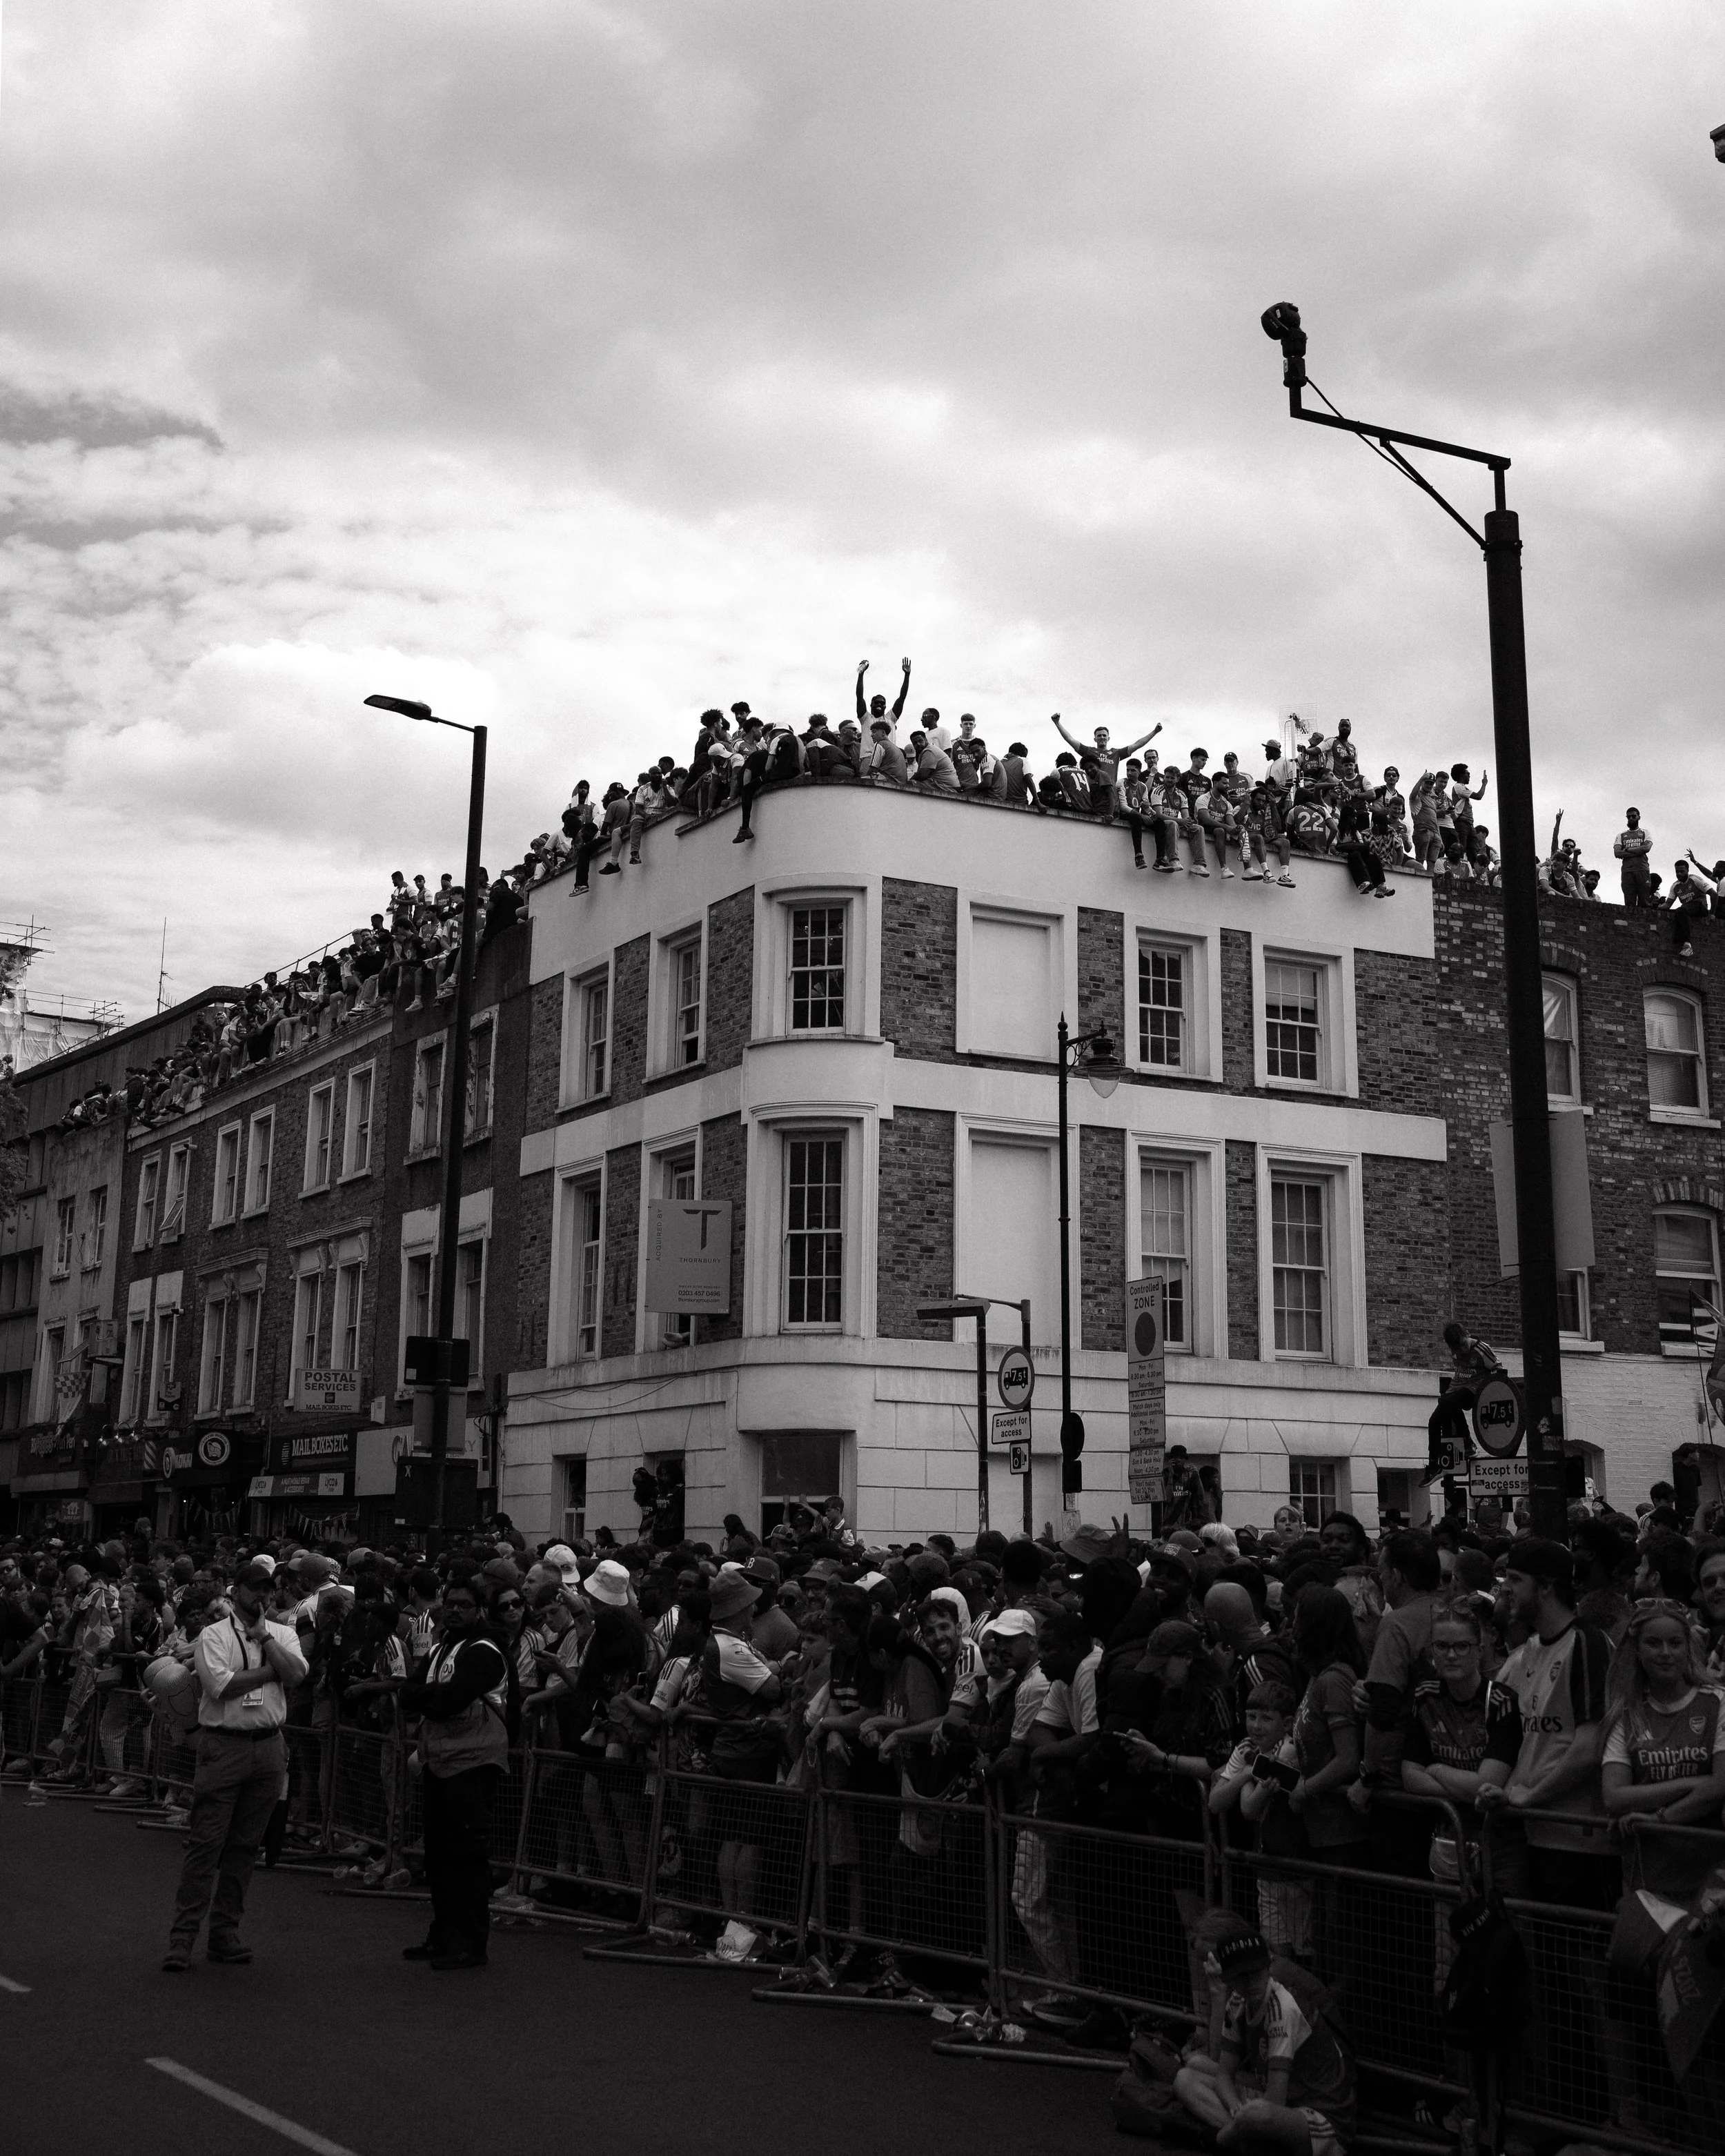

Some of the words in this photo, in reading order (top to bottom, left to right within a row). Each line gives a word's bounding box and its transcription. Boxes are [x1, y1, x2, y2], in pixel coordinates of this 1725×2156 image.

[1071, 772, 1090, 793] 14
[1298, 811, 1324, 832] 22
[658, 1209, 662, 1218] BY
[1130, 1282, 1159, 1295] Controlled
[1134, 1296, 1155, 1309] ZONE
[304, 1372, 356, 1383] POSTAL
[304, 1383, 356, 1391] SERVICES
[996, 1418, 1017, 1428] Except
[1018, 1416, 1027, 1425] for
[1000, 1429, 1022, 1437] access
[292, 1437, 310, 1456] MAIL
[311, 1435, 333, 1455] BOXES
[1475, 1464, 1510, 1476] Except
[1485, 1479, 1520, 1489] access
[747, 1557, 756, 1569] B
